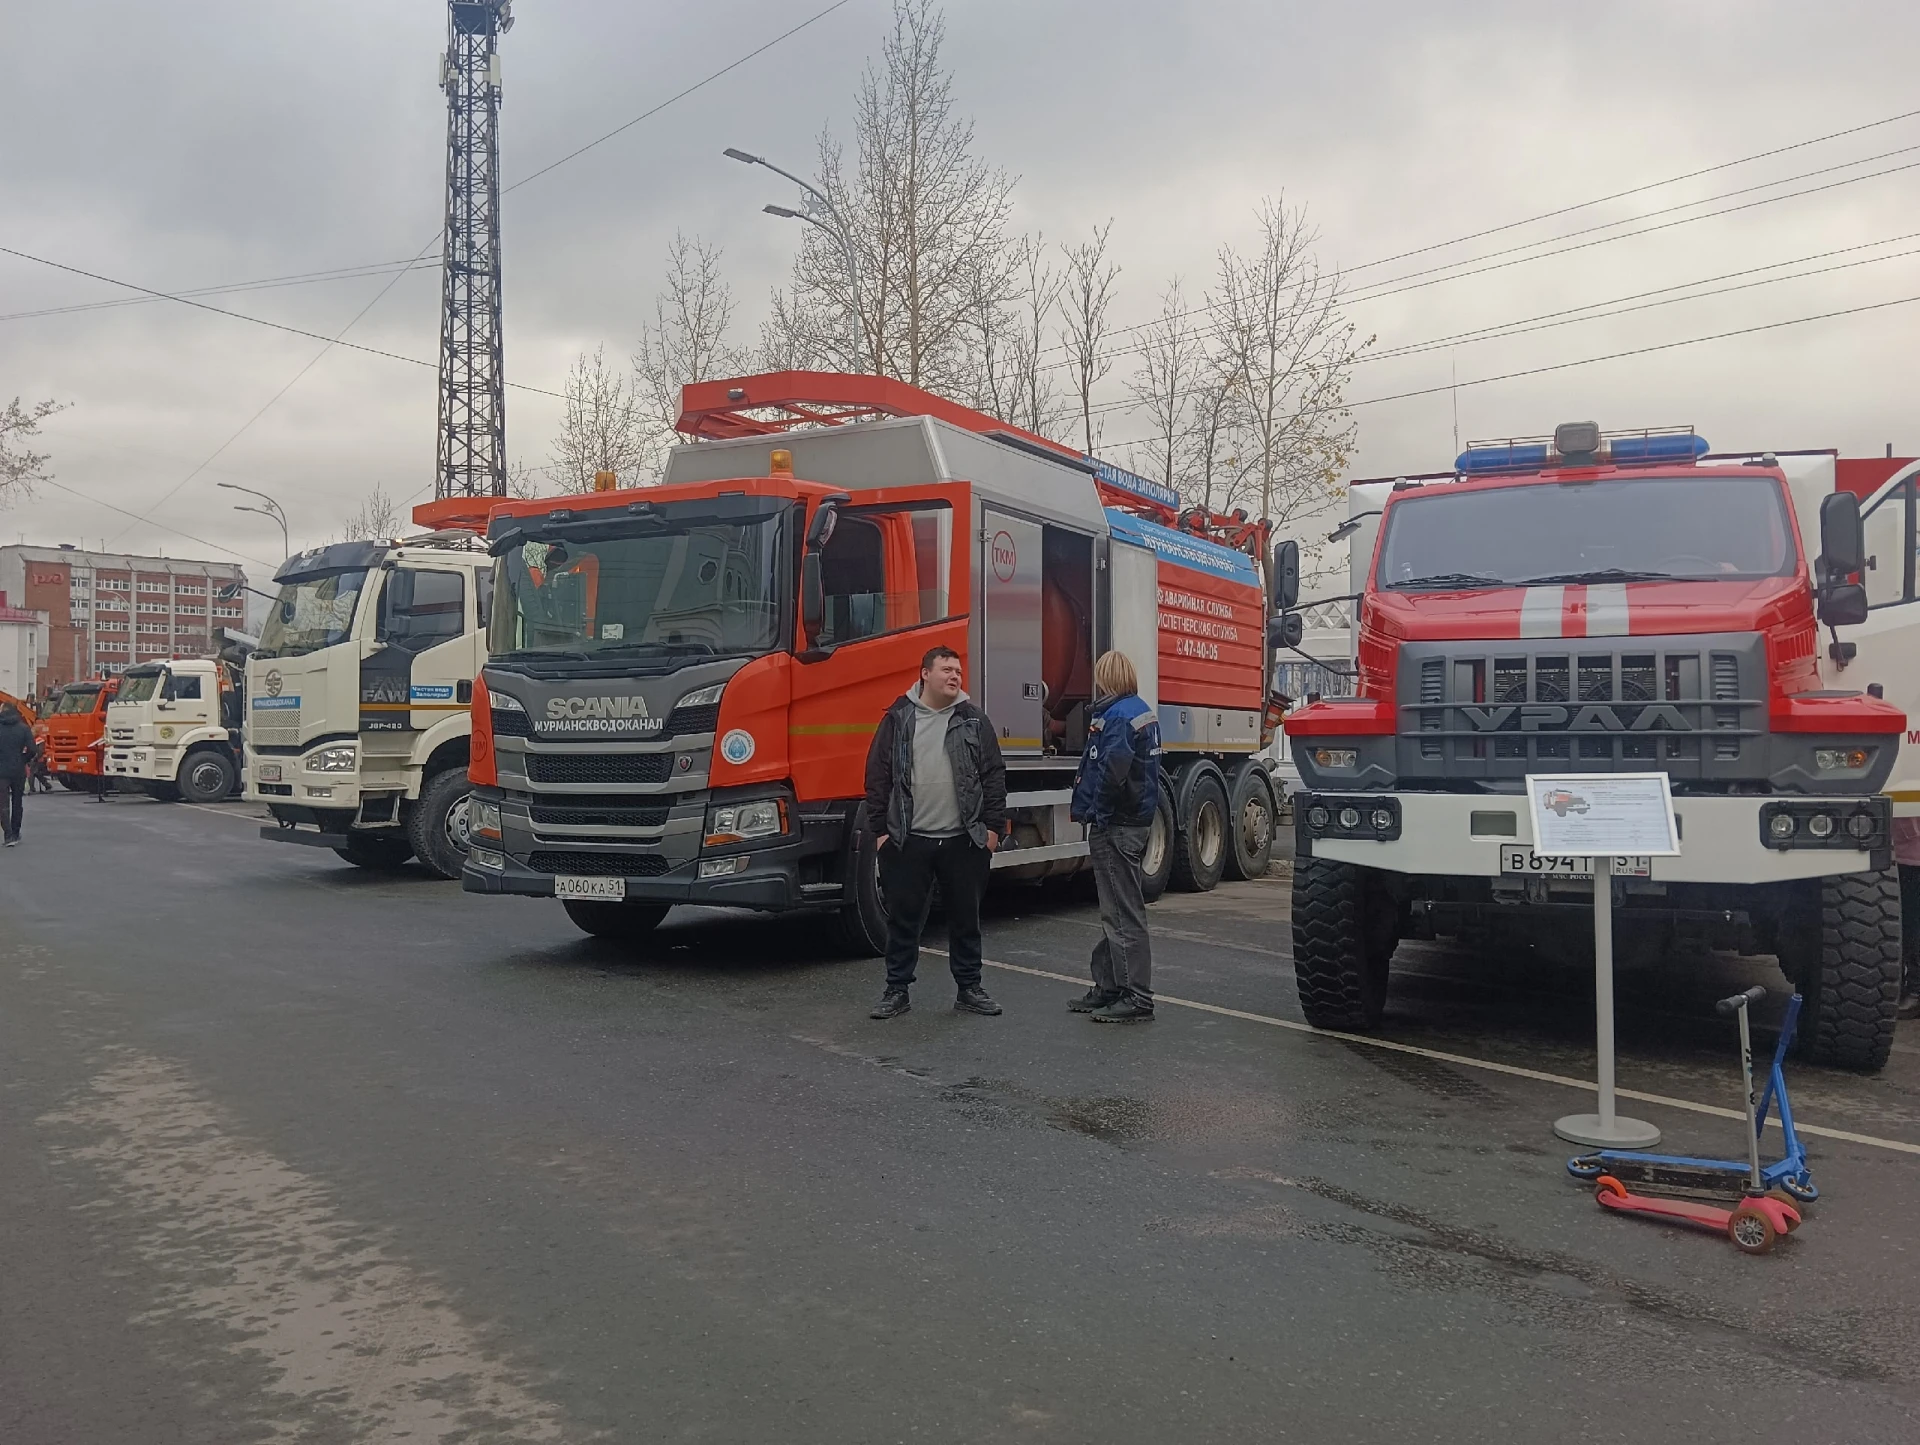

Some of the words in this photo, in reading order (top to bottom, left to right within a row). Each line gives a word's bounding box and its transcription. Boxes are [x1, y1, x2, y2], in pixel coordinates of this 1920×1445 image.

[1117, 472, 1137, 492] ВОДА
[1137, 477, 1175, 505] ЗАПОЛЯРЬЯ
[1164, 590, 1205, 613] АВАРИЙНАЯ
[1206, 600, 1233, 620] СЛУЖБА
[1157, 611, 1212, 636] ИСПЕТЧЕРСКАЯ
[1211, 623, 1238, 642] СЛУЖБА
[1184, 638, 1218, 661] 47-40-05
[362, 689, 408, 703] FAW
[546, 696, 649, 720] SCANIA
[1461, 705, 1693, 733] УРАЛ
[534, 718, 664, 733] МУРМАНСКВОДОКАНАЛ
[1511, 850, 1592, 872] В894Т
[1615, 867, 1634, 875] RUS
[608, 879, 620, 891] 51
